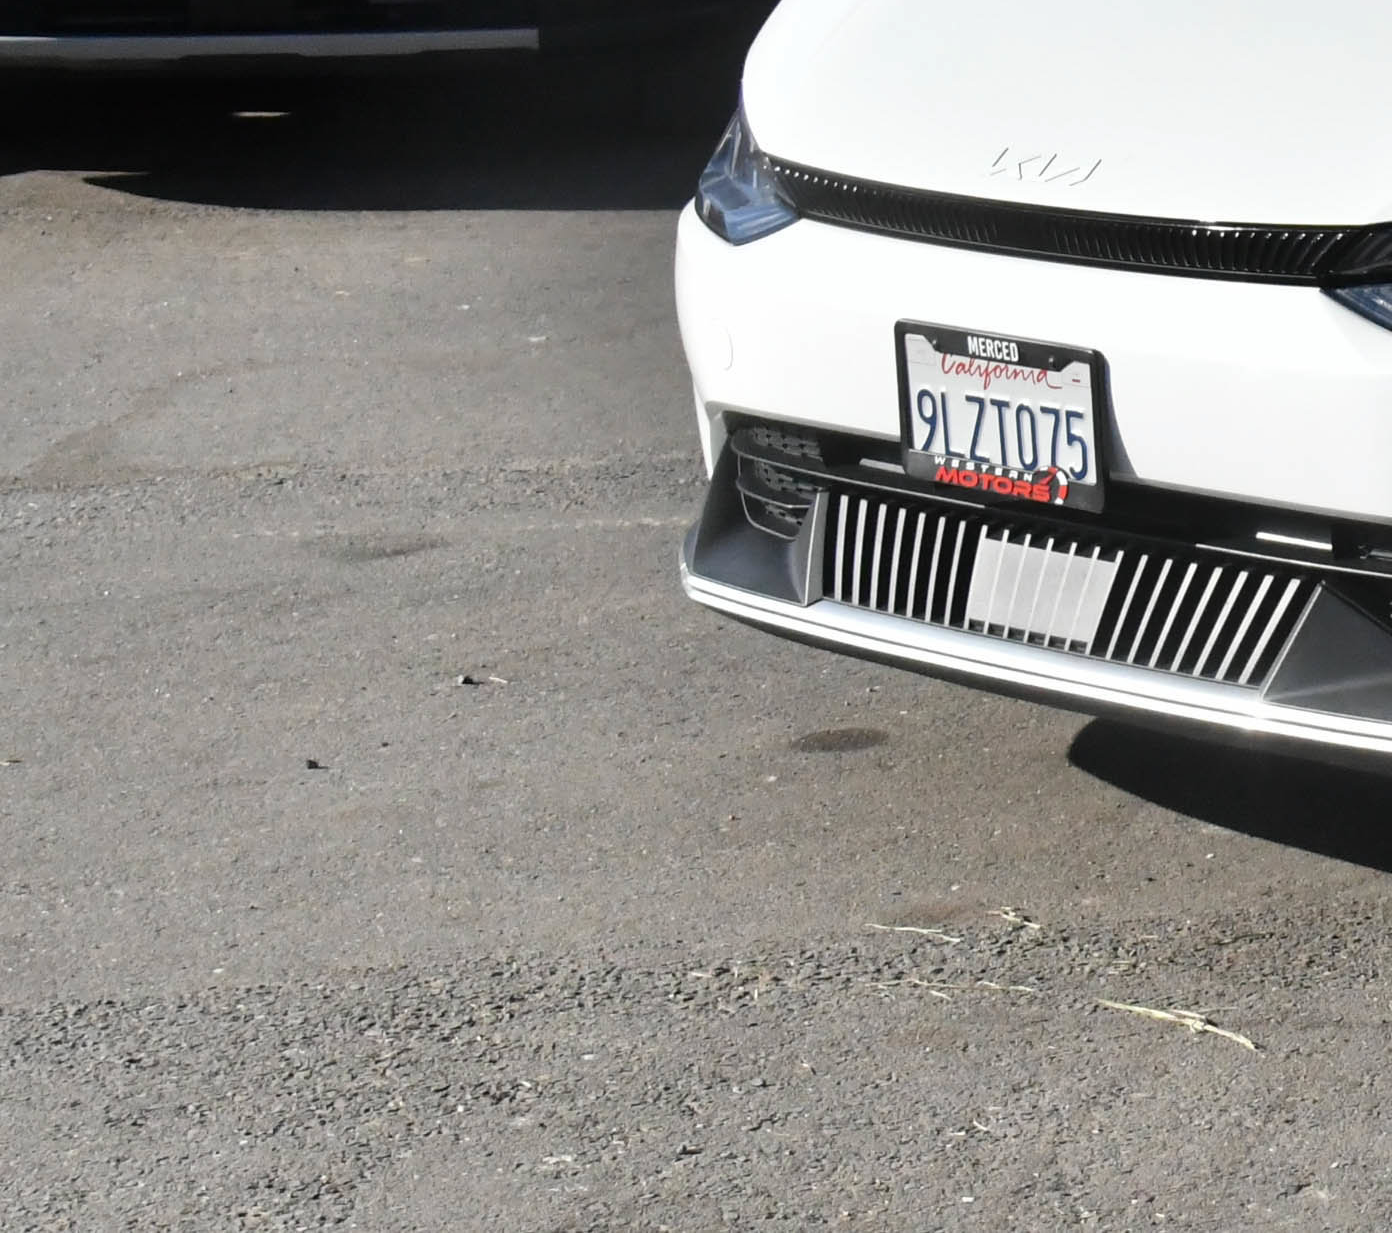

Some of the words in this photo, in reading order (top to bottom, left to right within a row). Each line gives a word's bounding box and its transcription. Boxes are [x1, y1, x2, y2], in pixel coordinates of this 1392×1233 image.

[967, 335, 1019, 362] MERCED
[942, 353, 1062, 390] California
[917, 389, 1088, 480] 9LZT075
[934, 455, 1033, 482] WESTERN
[936, 466, 1051, 502] MOTORS
